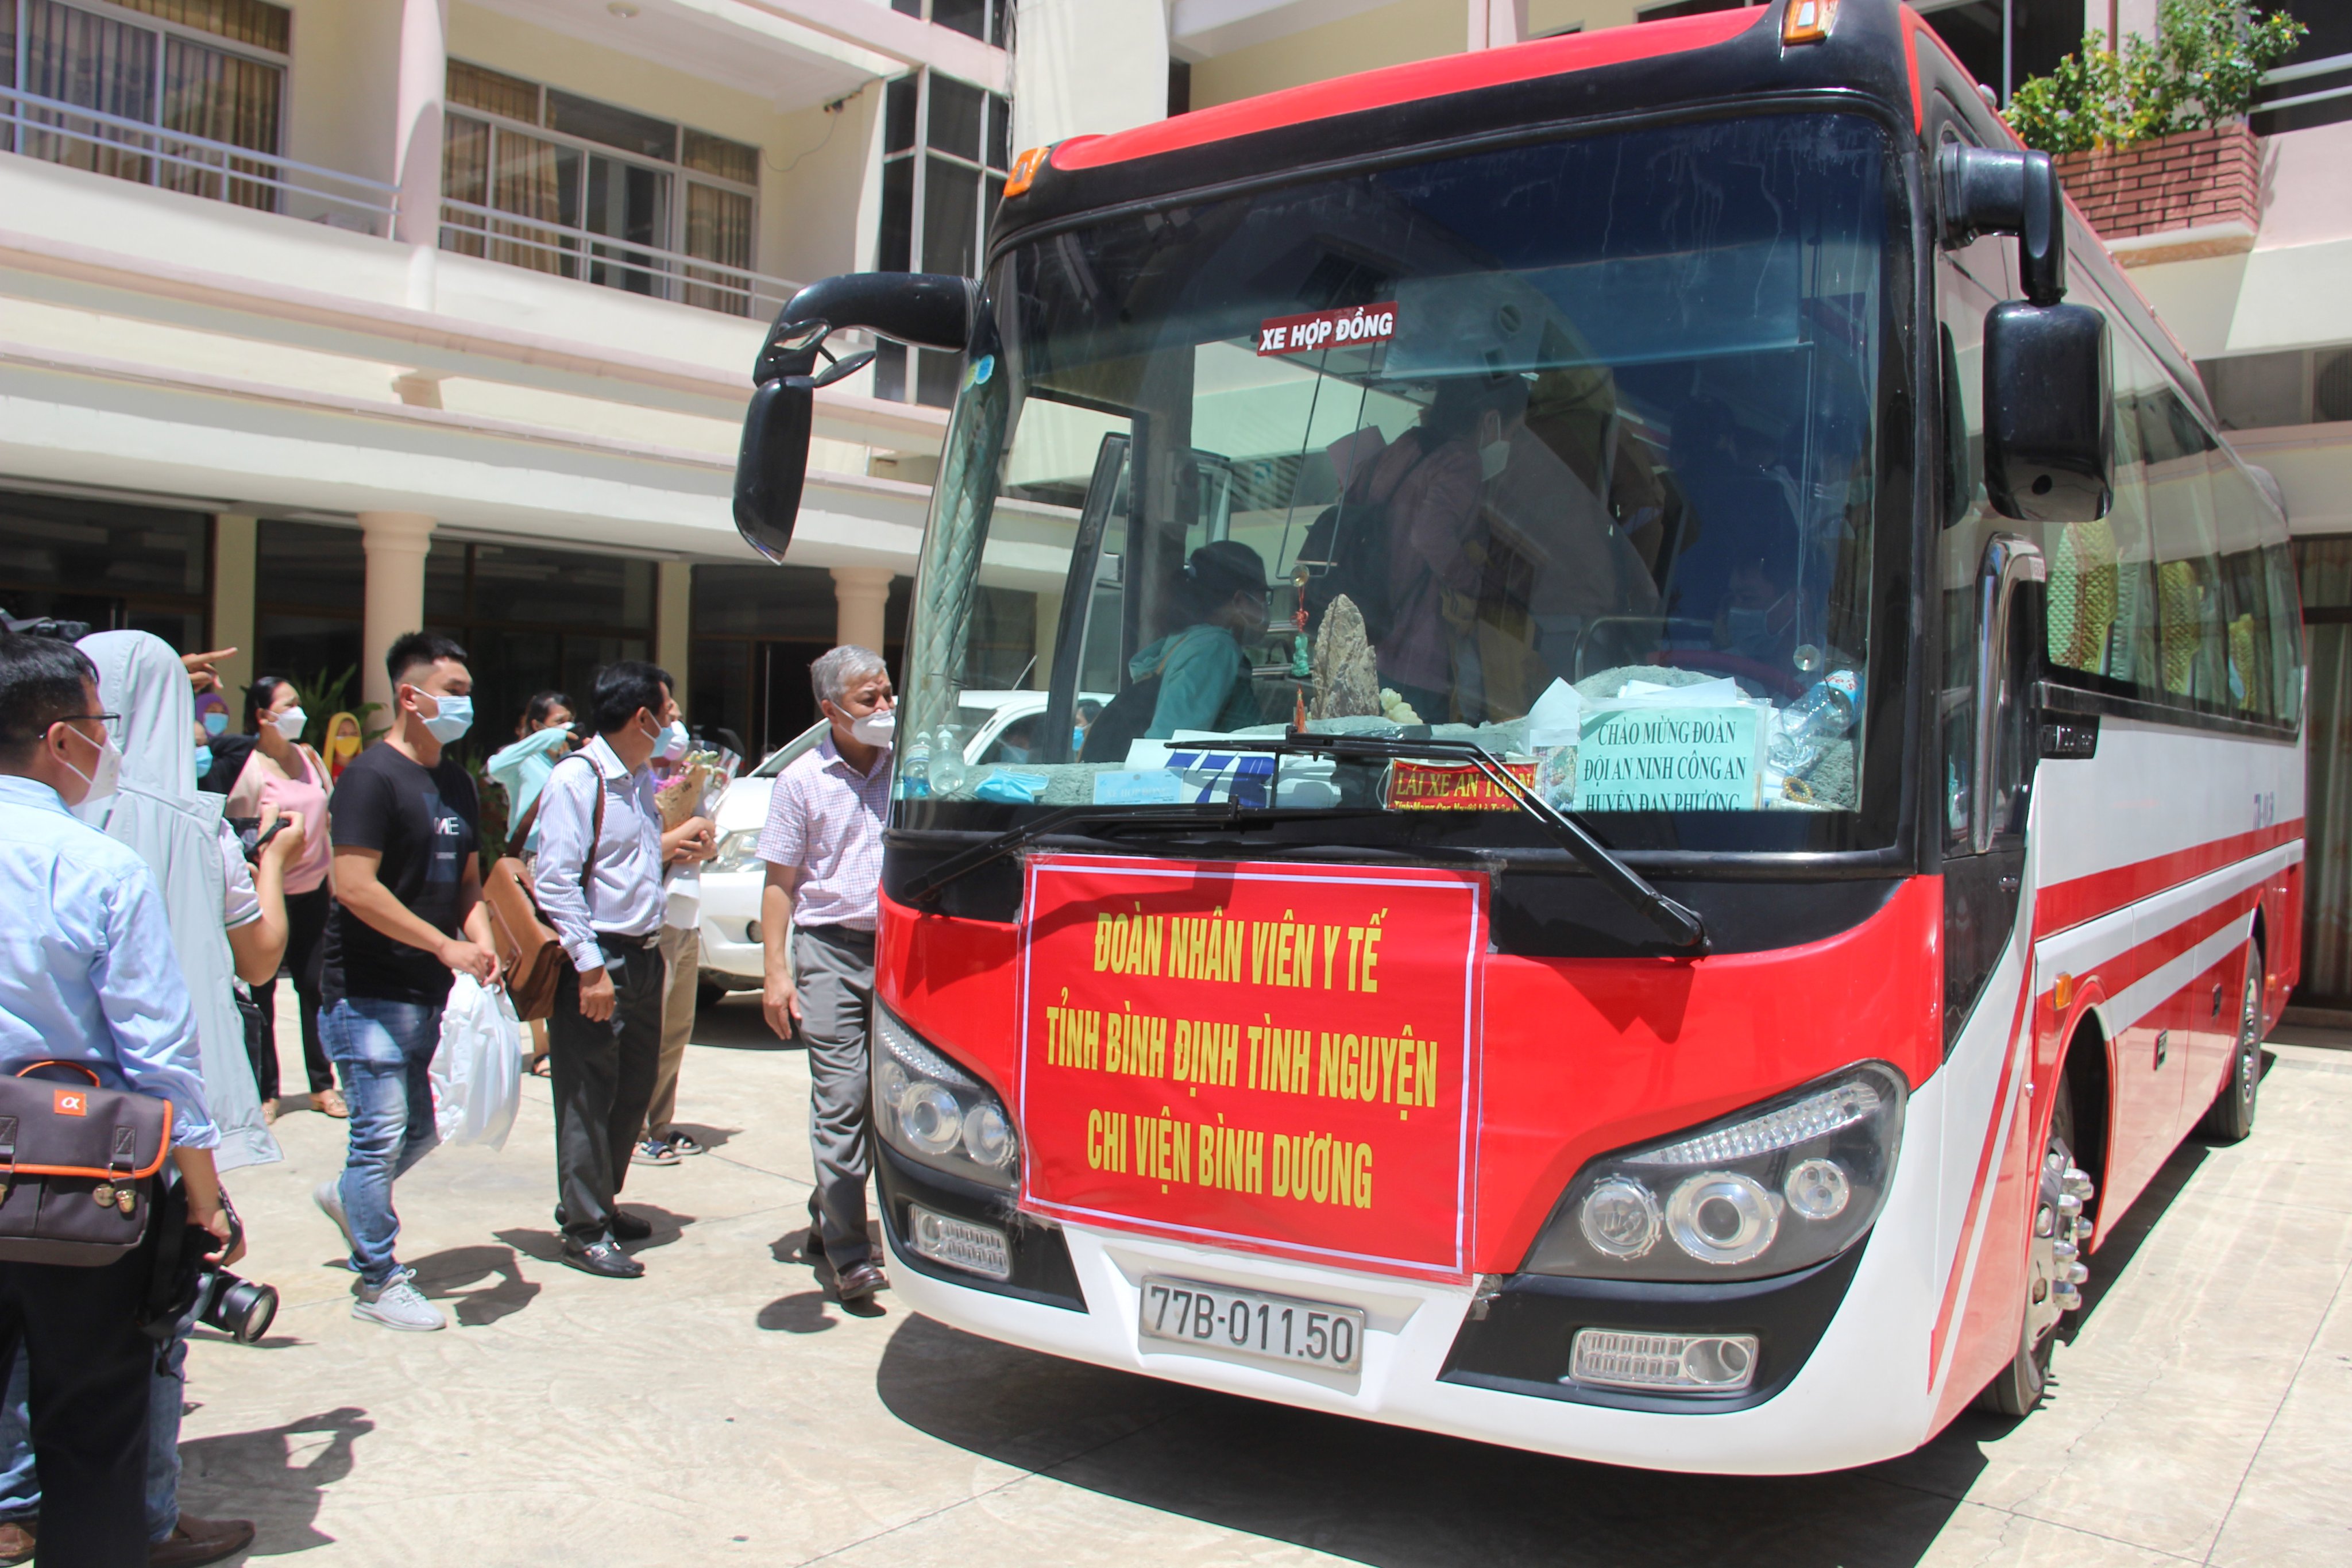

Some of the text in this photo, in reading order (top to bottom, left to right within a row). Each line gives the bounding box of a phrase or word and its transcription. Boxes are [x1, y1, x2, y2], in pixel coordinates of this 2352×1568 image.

[1259, 306, 1393, 351] XE HỢP ĐỒNG
[1598, 715, 1736, 746] CHÀO MỪNG ĐOÀN
[1396, 766, 1424, 796] LÁI
[1427, 773, 1451, 797] XE
[1454, 774, 1480, 797] AN
[1584, 750, 1746, 787] ĐỘI AN NINH CÔNG AN
[1094, 901, 1388, 993] ĐOÀN NHÂN VIÊN Y TẾ
[1046, 987, 1438, 1121] TỈNH BÌNH ĐỊNH TÌNH NGUYỆN
[1087, 1106, 1373, 1209] CHI VIỆN BÌNH DƯƠNG
[1151, 1285, 1353, 1364] 77B-011.50
